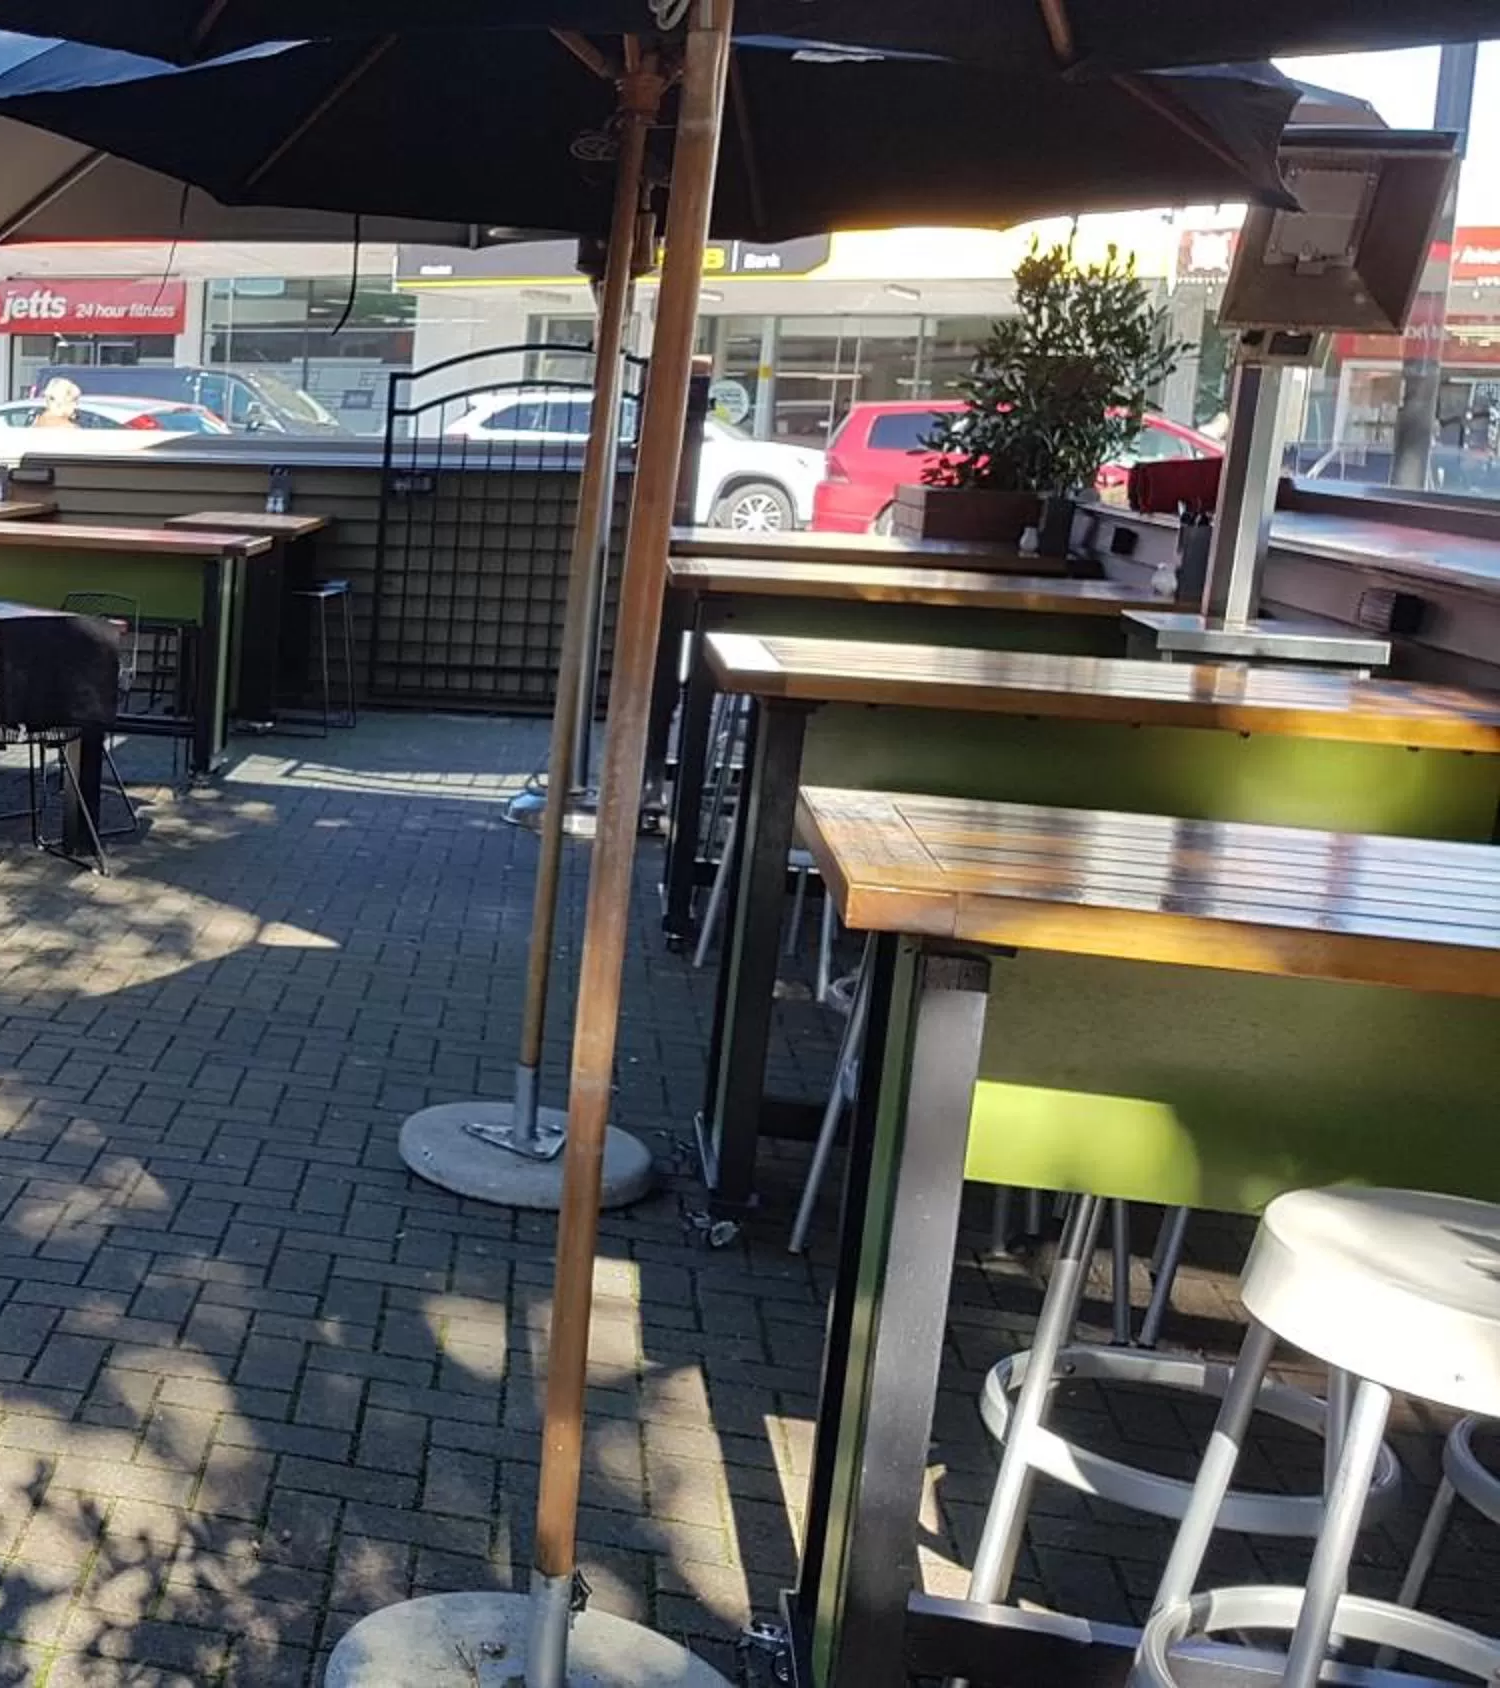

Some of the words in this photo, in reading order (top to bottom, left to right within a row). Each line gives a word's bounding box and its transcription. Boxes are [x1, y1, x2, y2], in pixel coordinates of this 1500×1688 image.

[743, 252, 781, 269] Bank
[0, 289, 67, 325] jetts
[75, 303, 94, 318] 24
[94, 303, 128, 318] hour
[128, 302, 176, 318] fitness
